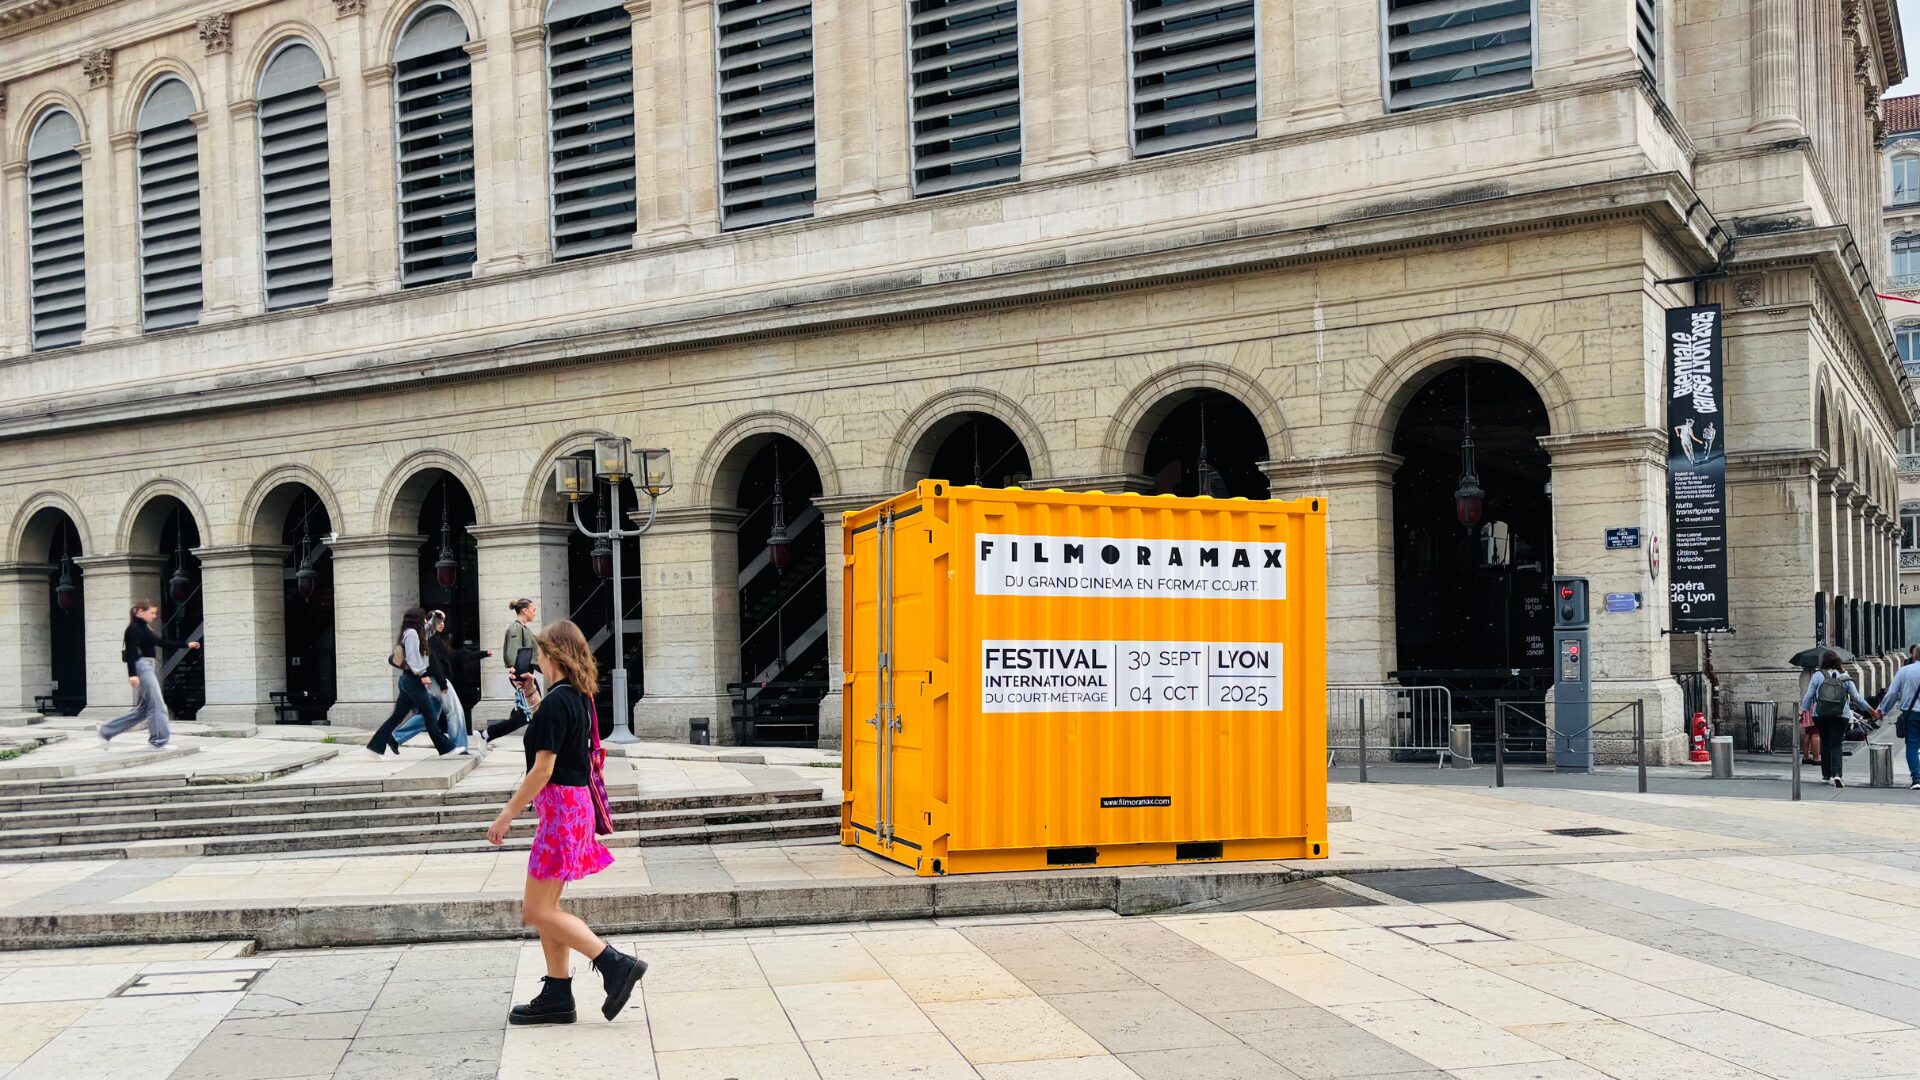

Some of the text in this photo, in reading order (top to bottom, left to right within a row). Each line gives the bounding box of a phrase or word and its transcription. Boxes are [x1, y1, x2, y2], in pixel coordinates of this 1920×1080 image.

[1691, 311, 1716, 341] 2025
[981, 541, 1282, 568] FILMORAMAX
[1006, 575, 1024, 588] DU
[1028, 576, 1078, 588] GRAND
[1138, 578, 1153, 590] EN
[1158, 578, 1208, 591] FORMAT
[1671, 580, 1705, 593] opéra
[1671, 591, 1715, 604] de Lyon
[986, 648, 1107, 669] FESTIVAL
[1128, 651, 1201, 670] 30 SEPT
[1218, 650, 1269, 668] LYON
[986, 675, 1107, 688] INTERNATIONAL
[986, 691, 1108, 703] DU COURT-MÉTRAGE
[1130, 686, 1198, 704] 04 OCT
[1220, 685, 1268, 706] 2025
[1103, 798, 1170, 807] www.filmoramax.com
